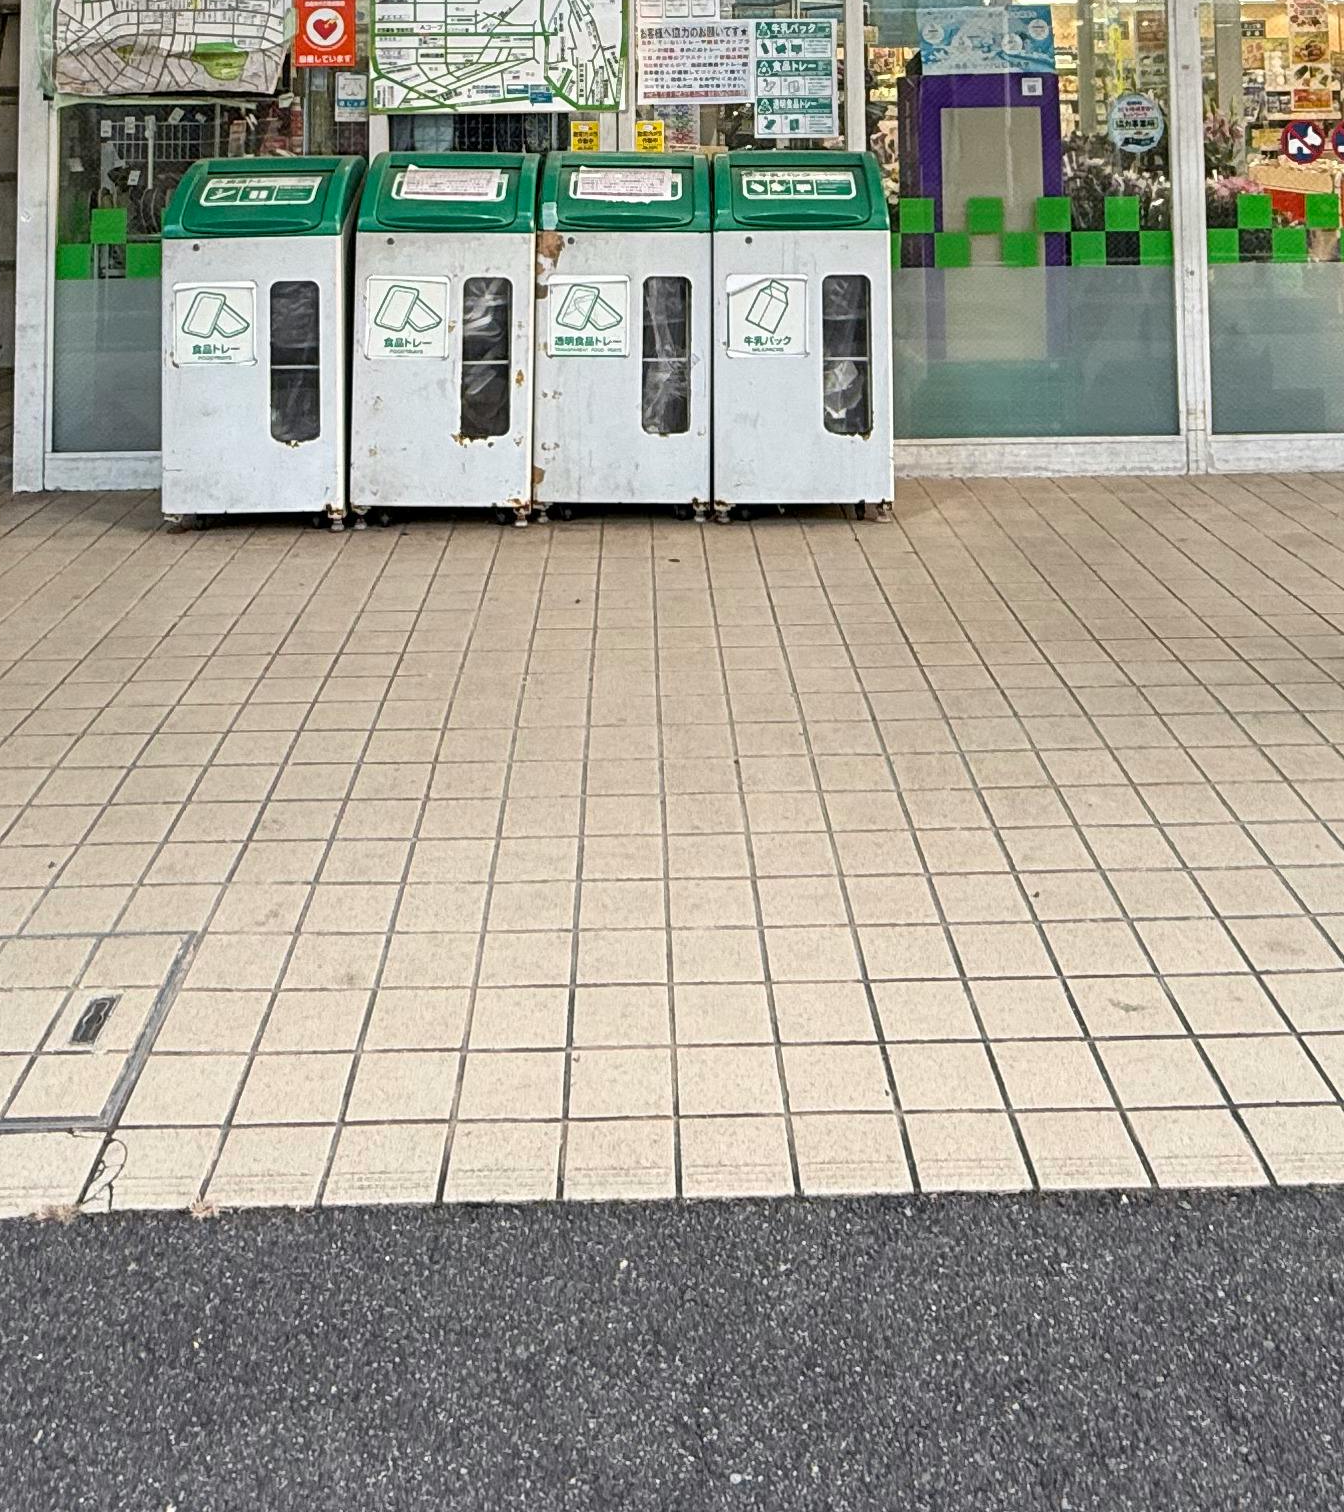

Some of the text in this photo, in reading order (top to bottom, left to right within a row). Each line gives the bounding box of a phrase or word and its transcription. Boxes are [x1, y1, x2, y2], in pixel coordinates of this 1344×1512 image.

[772, 60, 817, 73] 食品トレー
[383, 336, 433, 348] 食品トレー
[554, 335, 623, 347] 透明食品トレー
[743, 335, 792, 347] 牛乳パック
[191, 343, 241, 355] 食品トレー
